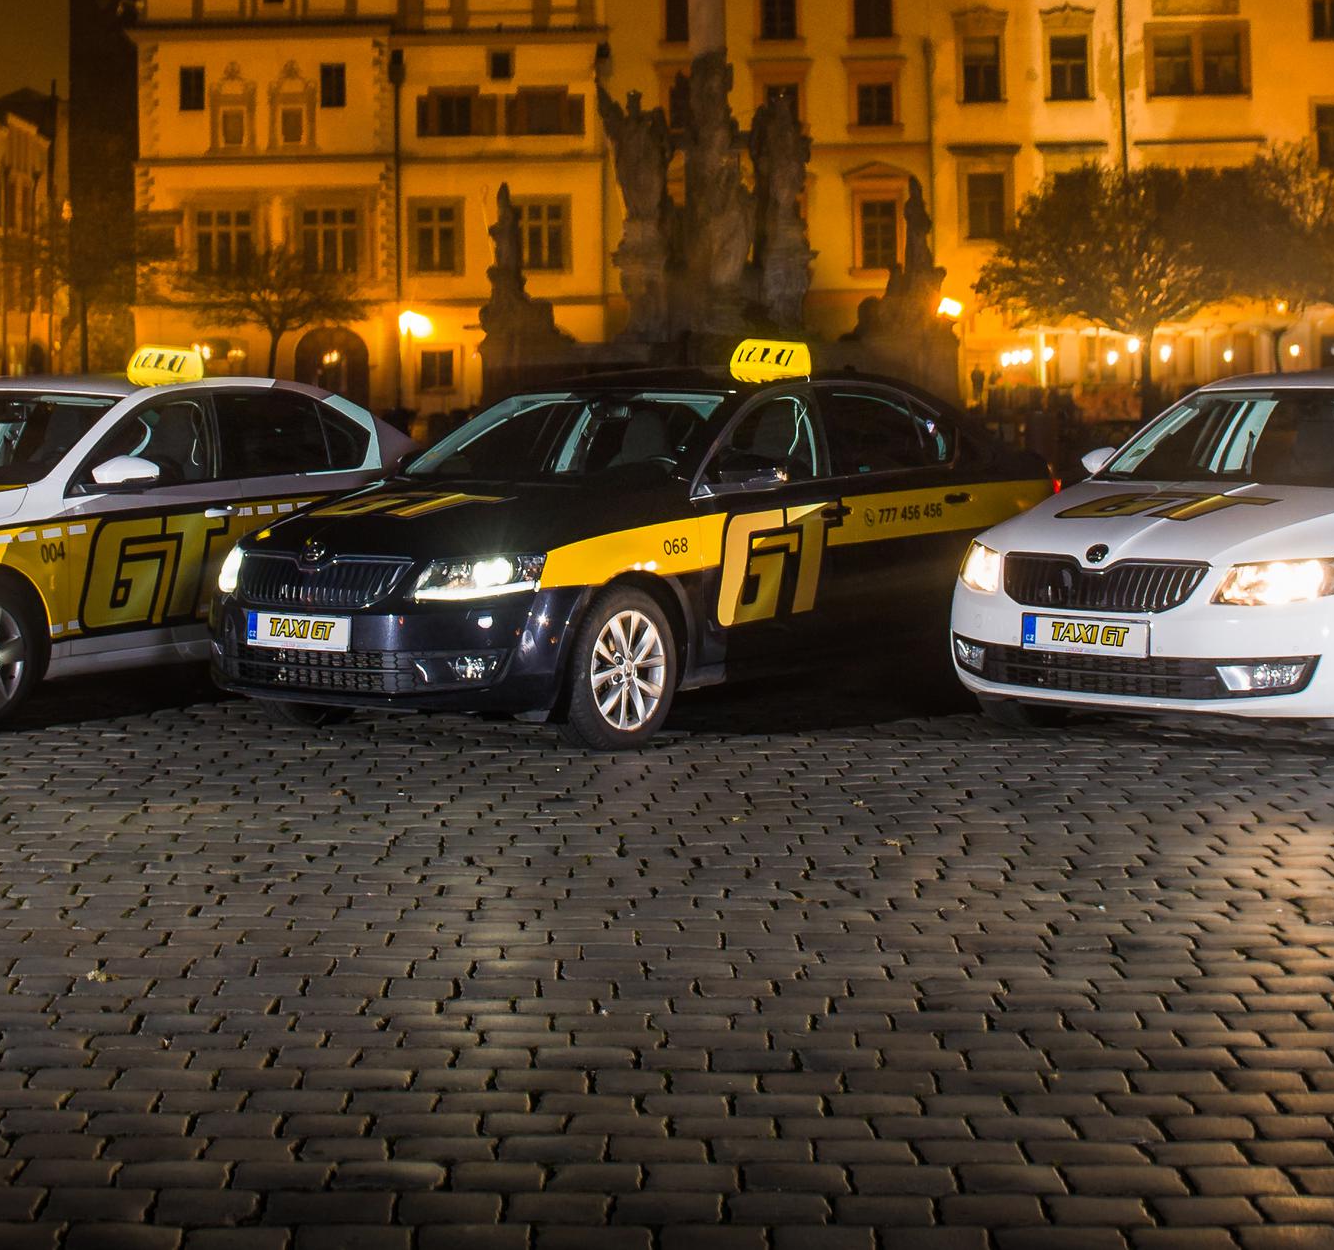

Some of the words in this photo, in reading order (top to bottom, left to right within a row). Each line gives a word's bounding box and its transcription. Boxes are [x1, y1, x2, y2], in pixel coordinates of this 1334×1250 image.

[878, 507, 897, 524] 777
[901, 505, 921, 521] 456
[923, 502, 943, 518] 456
[1053, 491, 1284, 521] GT
[41, 541, 65, 564] 004
[663, 537, 688, 556] 068
[79, 511, 228, 632] GT
[717, 502, 839, 627] GT
[270, 617, 310, 639] TAXI
[311, 621, 335, 641] GT
[1025, 633, 1034, 642] CZ
[1052, 621, 1099, 644] TAXI
[1100, 625, 1130, 647] GT
